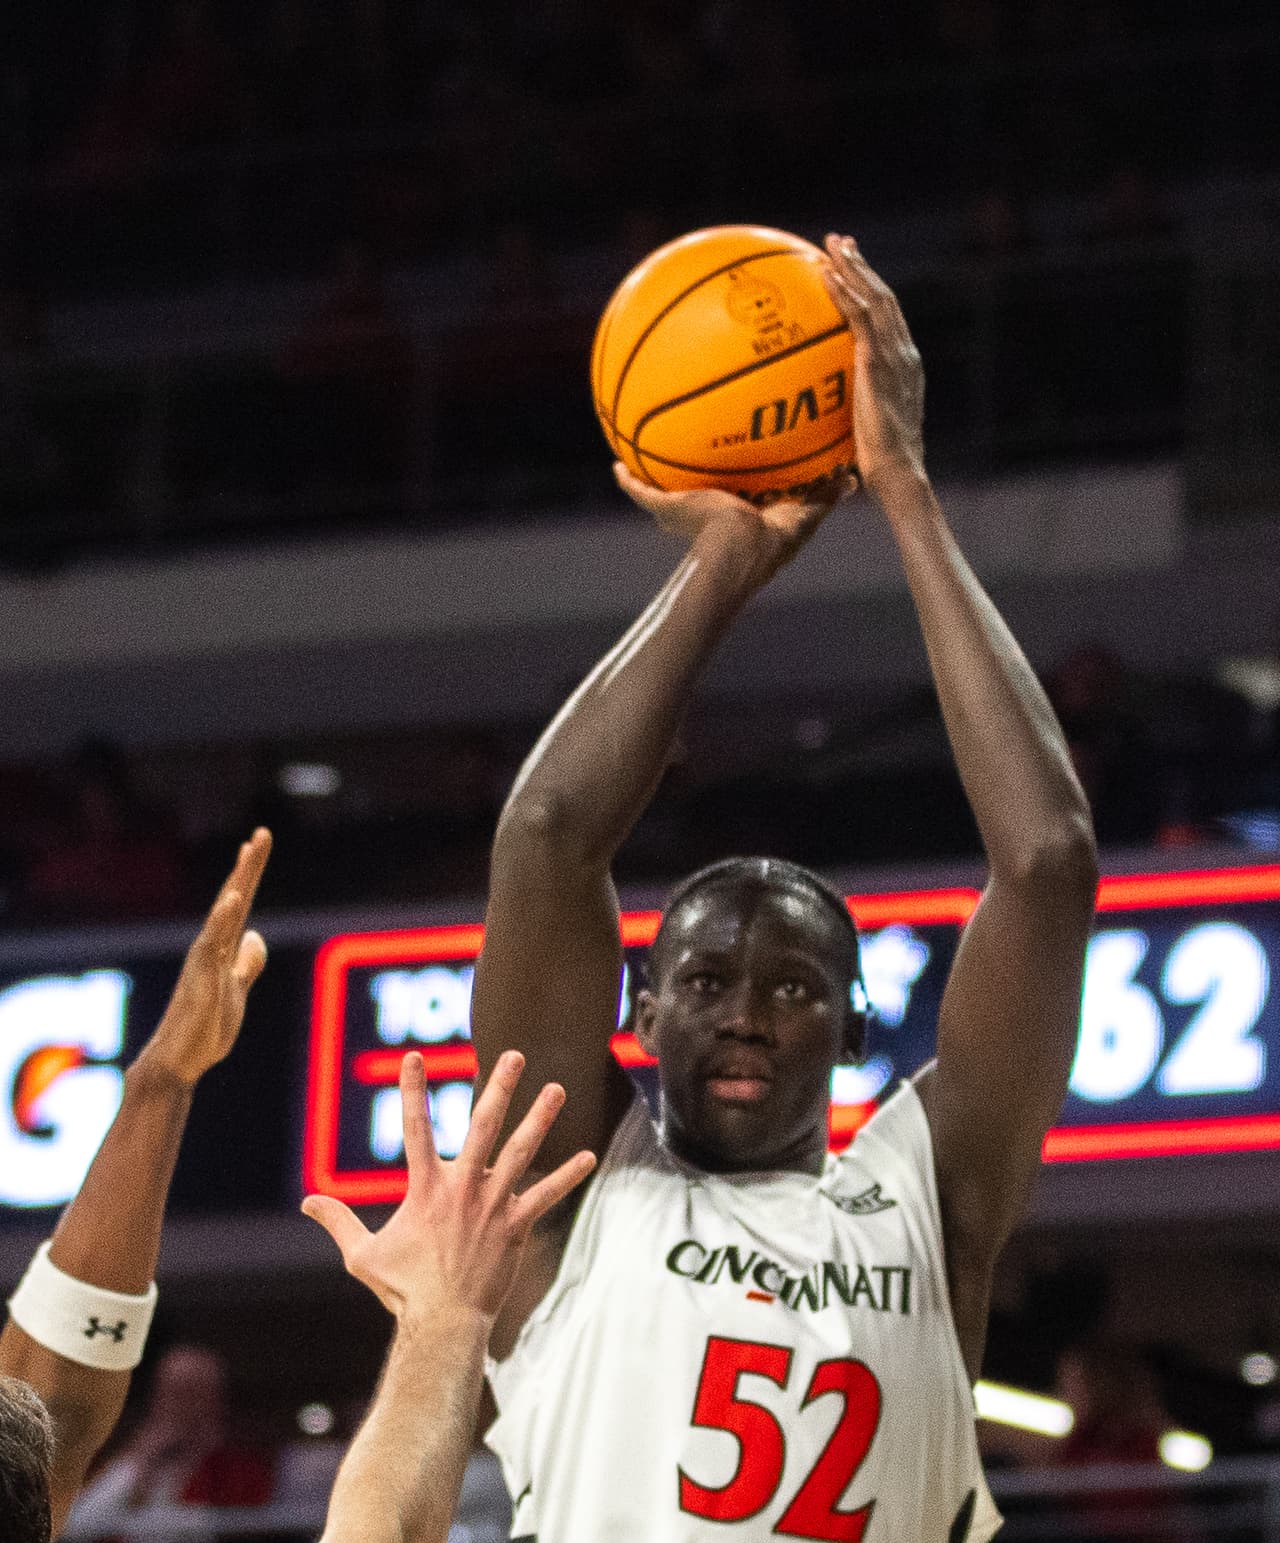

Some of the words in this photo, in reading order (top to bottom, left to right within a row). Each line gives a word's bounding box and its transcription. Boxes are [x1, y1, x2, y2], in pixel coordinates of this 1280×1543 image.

[749, 369, 846, 442] EVO
[1067, 920, 1270, 1103] 62
[665, 1238, 912, 1316] CINCINNATI
